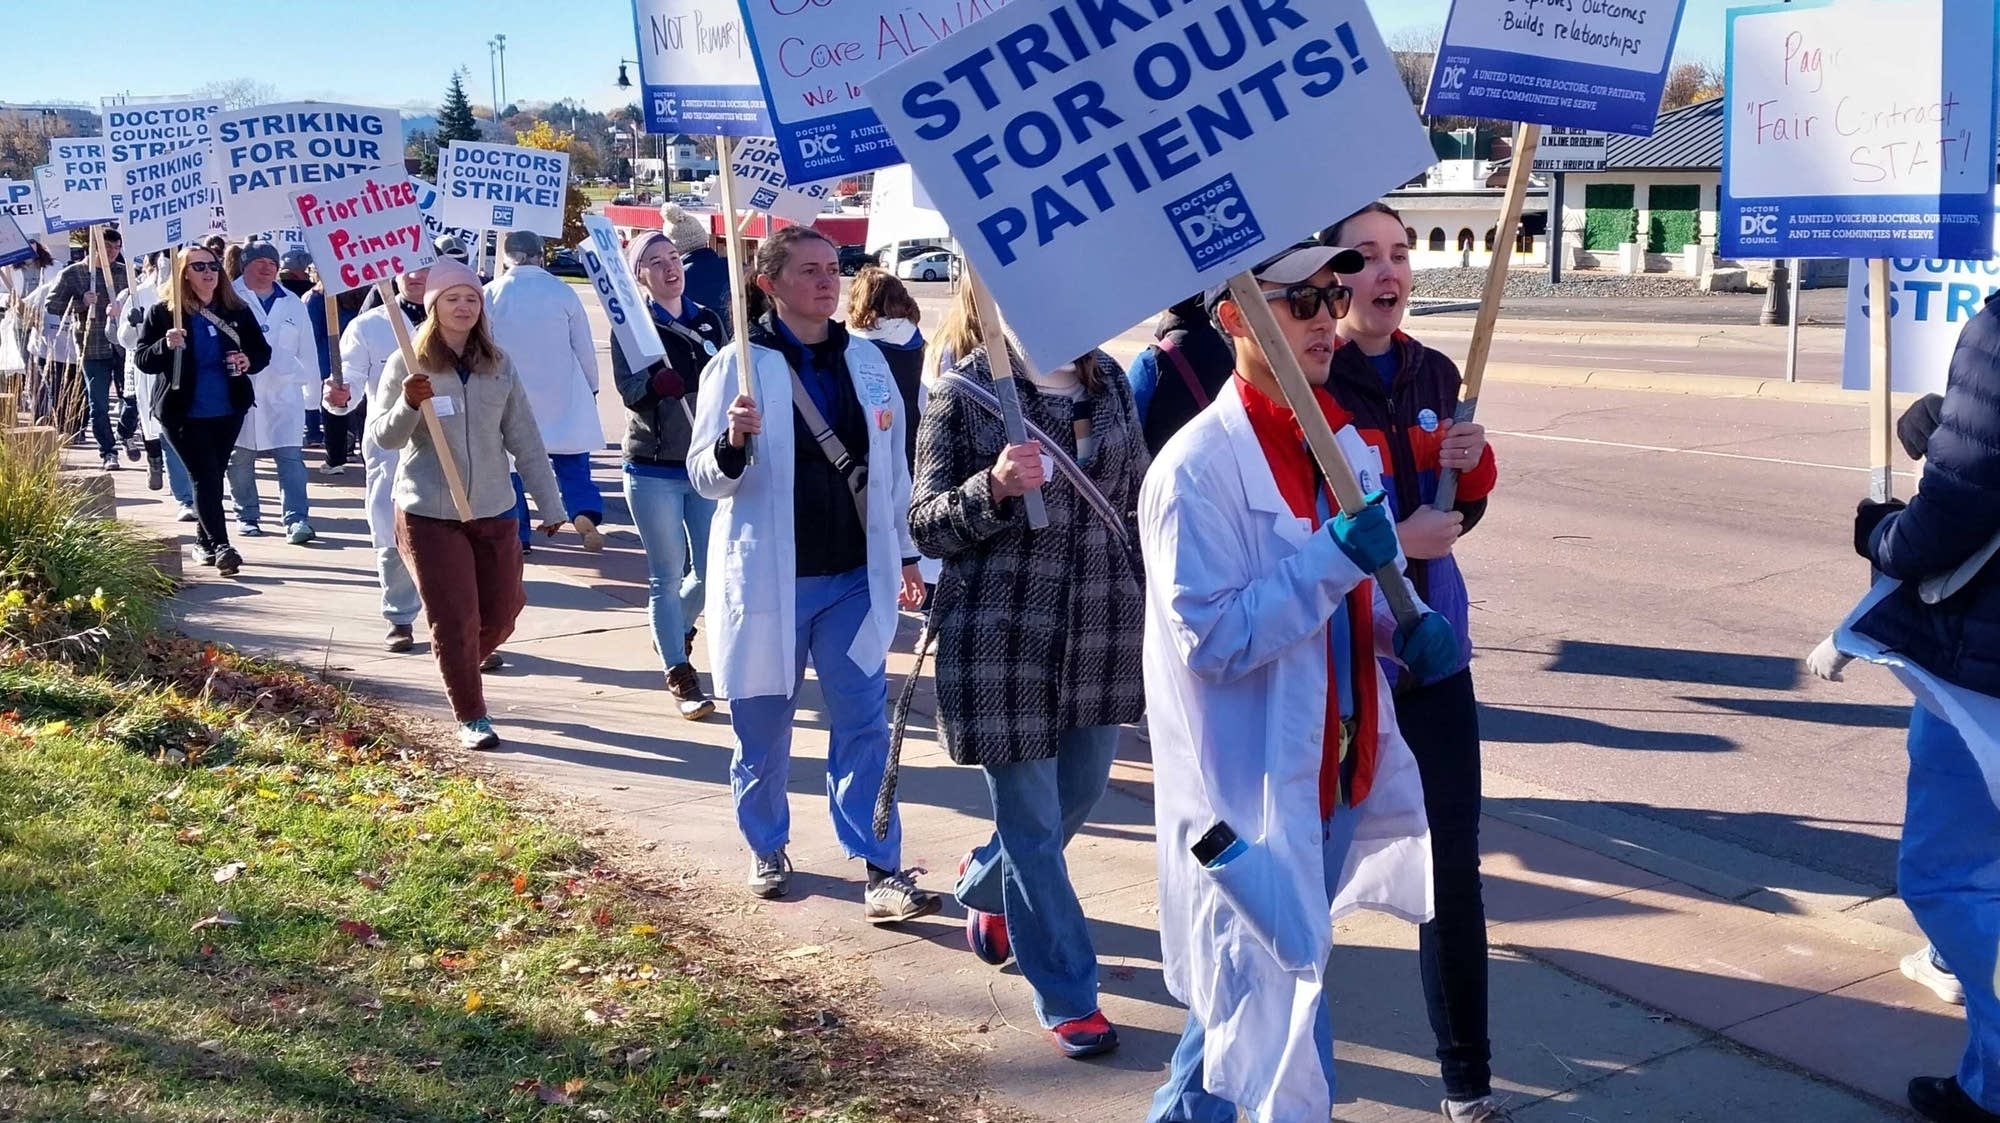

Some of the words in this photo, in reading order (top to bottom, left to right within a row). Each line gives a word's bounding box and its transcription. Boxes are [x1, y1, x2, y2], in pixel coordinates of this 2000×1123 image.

[650, 13, 688, 55] NOT
[1503, 11, 1545, 36] Builds
[1554, 19, 1641, 56] relationships
[779, 37, 864, 78] Care
[803, 86, 838, 107] We
[953, 80, 1123, 200] FOR
[1134, 0, 1308, 101] OUR
[1468, 86, 1485, 97] AND
[1485, 87, 1502, 98] THE
[1502, 89, 1560, 106] COMMUNITIES
[1560, 97, 1573, 108] WE
[1573, 99, 1598, 111] SERVE
[1472, 69, 1479, 79] A
[1480, 70, 1508, 82] UNITED
[1509, 73, 1535, 86] VOICE
[1535, 77, 1552, 88] FOR
[1552, 80, 1589, 94] DOCTORS,
[1590, 85, 1608, 96] OUR
[1608, 87, 1646, 102] PATIENTS,
[110, 126, 192, 142] COUNCIL
[219, 112, 383, 143] STRIKING
[795, 123, 837, 138] DOCTORS
[850, 129, 858, 139] A
[859, 124, 888, 137] UNIT
[59, 144, 105, 159] STR
[230, 139, 298, 168] FOR
[308, 138, 381, 160] OUR
[739, 147, 780, 166] FOR
[854, 141, 877, 153] AND
[877, 137, 896, 149] TH
[977, 21, 1368, 267] PATIENTS!
[65, 161, 106, 175] FOR
[126, 152, 203, 185] STRIKING
[455, 147, 562, 173] DOCTORS
[804, 154, 846, 169] COUNCIL
[64, 178, 108, 192] PAT
[131, 183, 166, 204] FOR
[171, 172, 201, 193] OUR
[229, 163, 381, 195] PATIENT
[453, 165, 531, 184] COUNCIL
[536, 174, 561, 188] ON
[129, 188, 208, 225] PATIENTS!
[296, 179, 417, 227] Prioritize
[451, 180, 560, 208] STRIKE!
[1171, 180, 1233, 216] DOCTORS
[422, 212, 479, 246] RIKE!
[1788, 215, 1797, 224] A
[1798, 214, 1833, 224] UNITED
[1834, 214, 1861, 223] VOICE
[1861, 214, 1877, 223] FOR
[1879, 214, 1922, 225] DOCTORS,
[1923, 214, 1941, 223] OUR
[1942, 214, 1980, 225] PATIENTS,
[1788, 230, 1810, 239] AND
[1811, 230, 1831, 238] THE
[1832, 229, 1890, 239] COMMUNITIES
[1892, 230, 1907, 239] WE
[1908, 230, 1934, 239] SERVE
[327, 224, 421, 261] Primary
[1195, 226, 1255, 259] COUNCIL
[1740, 236, 1778, 244] COUNCIL
